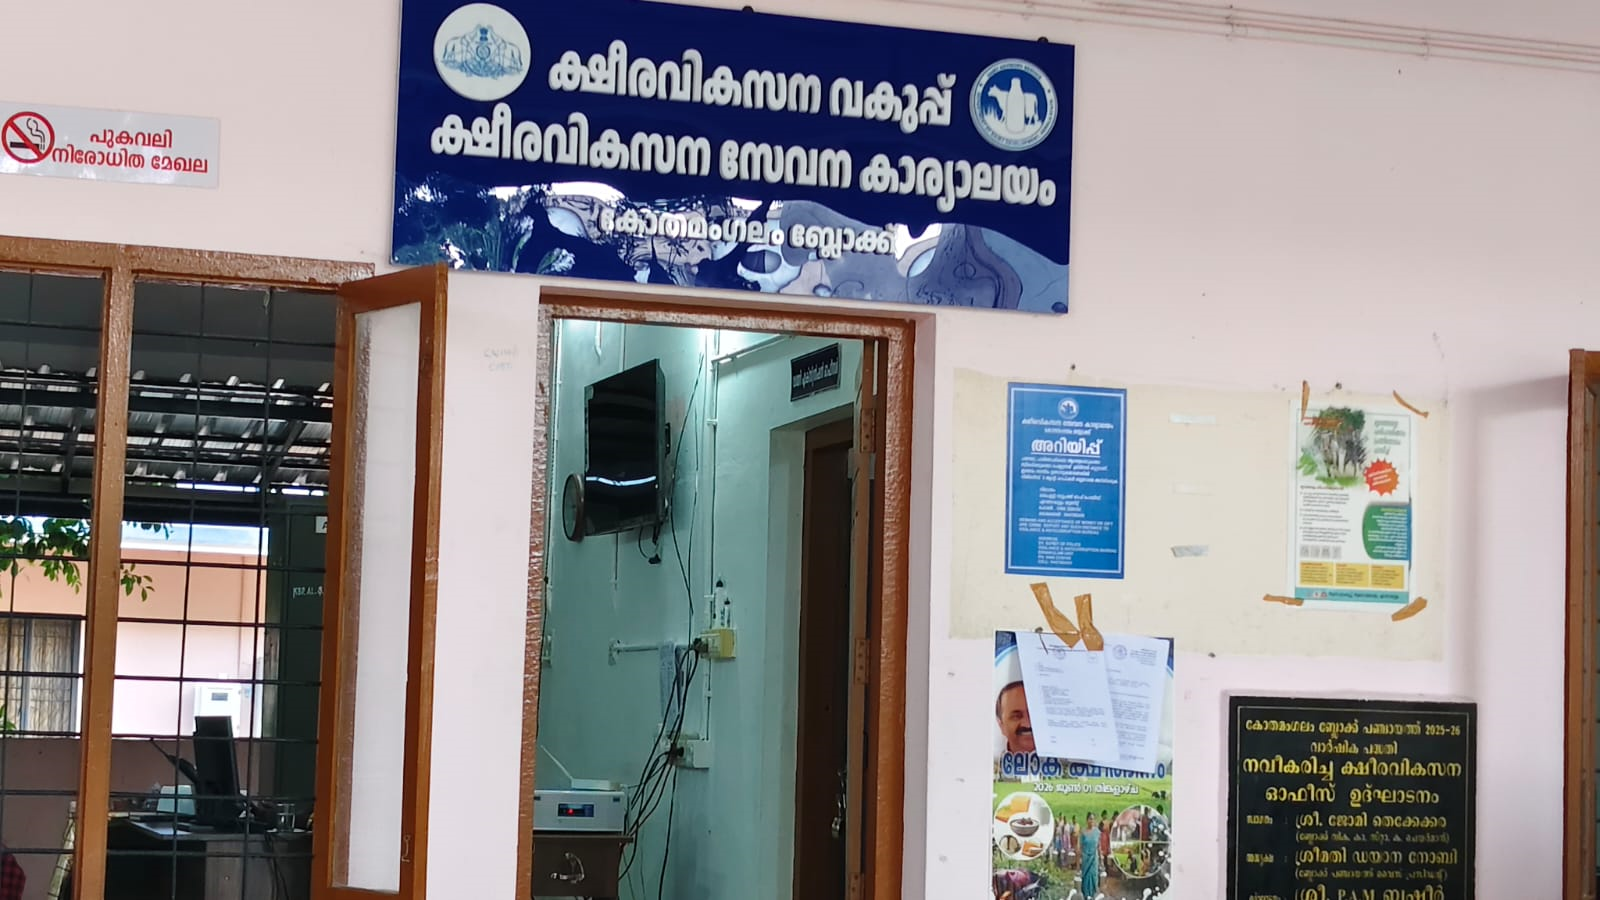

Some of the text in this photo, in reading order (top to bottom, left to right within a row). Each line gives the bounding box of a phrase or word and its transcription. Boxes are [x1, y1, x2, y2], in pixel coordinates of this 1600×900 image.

[548, 39, 822, 115] ക്ഷീരവികസന
[829, 72, 957, 134] വകുപ്പ്
[90, 128, 173, 149] പുകവലി
[52, 144, 208, 174] നിരോധിത മേഖല
[430, 102, 1057, 213] ക്ഷീരവികസന സേവന കാര്യാലയം
[598, 207, 784, 246] കോതമംഗലം
[1031, 436, 1104, 455] അറിയിപ്പ്
[1424, 723, 1461, 736] 2025-26
[1002, 751, 1062, 776] ലോക
[1242, 755, 1462, 781] നവീകരിച്ച ക്ഷീരവികസന
[1328, 812, 1367, 828] ജോമി
[1295, 846, 1347, 866] ശ്രീമതി
[1353, 851, 1402, 864] ഡയാന
[1408, 848, 1458, 865] നോബി
